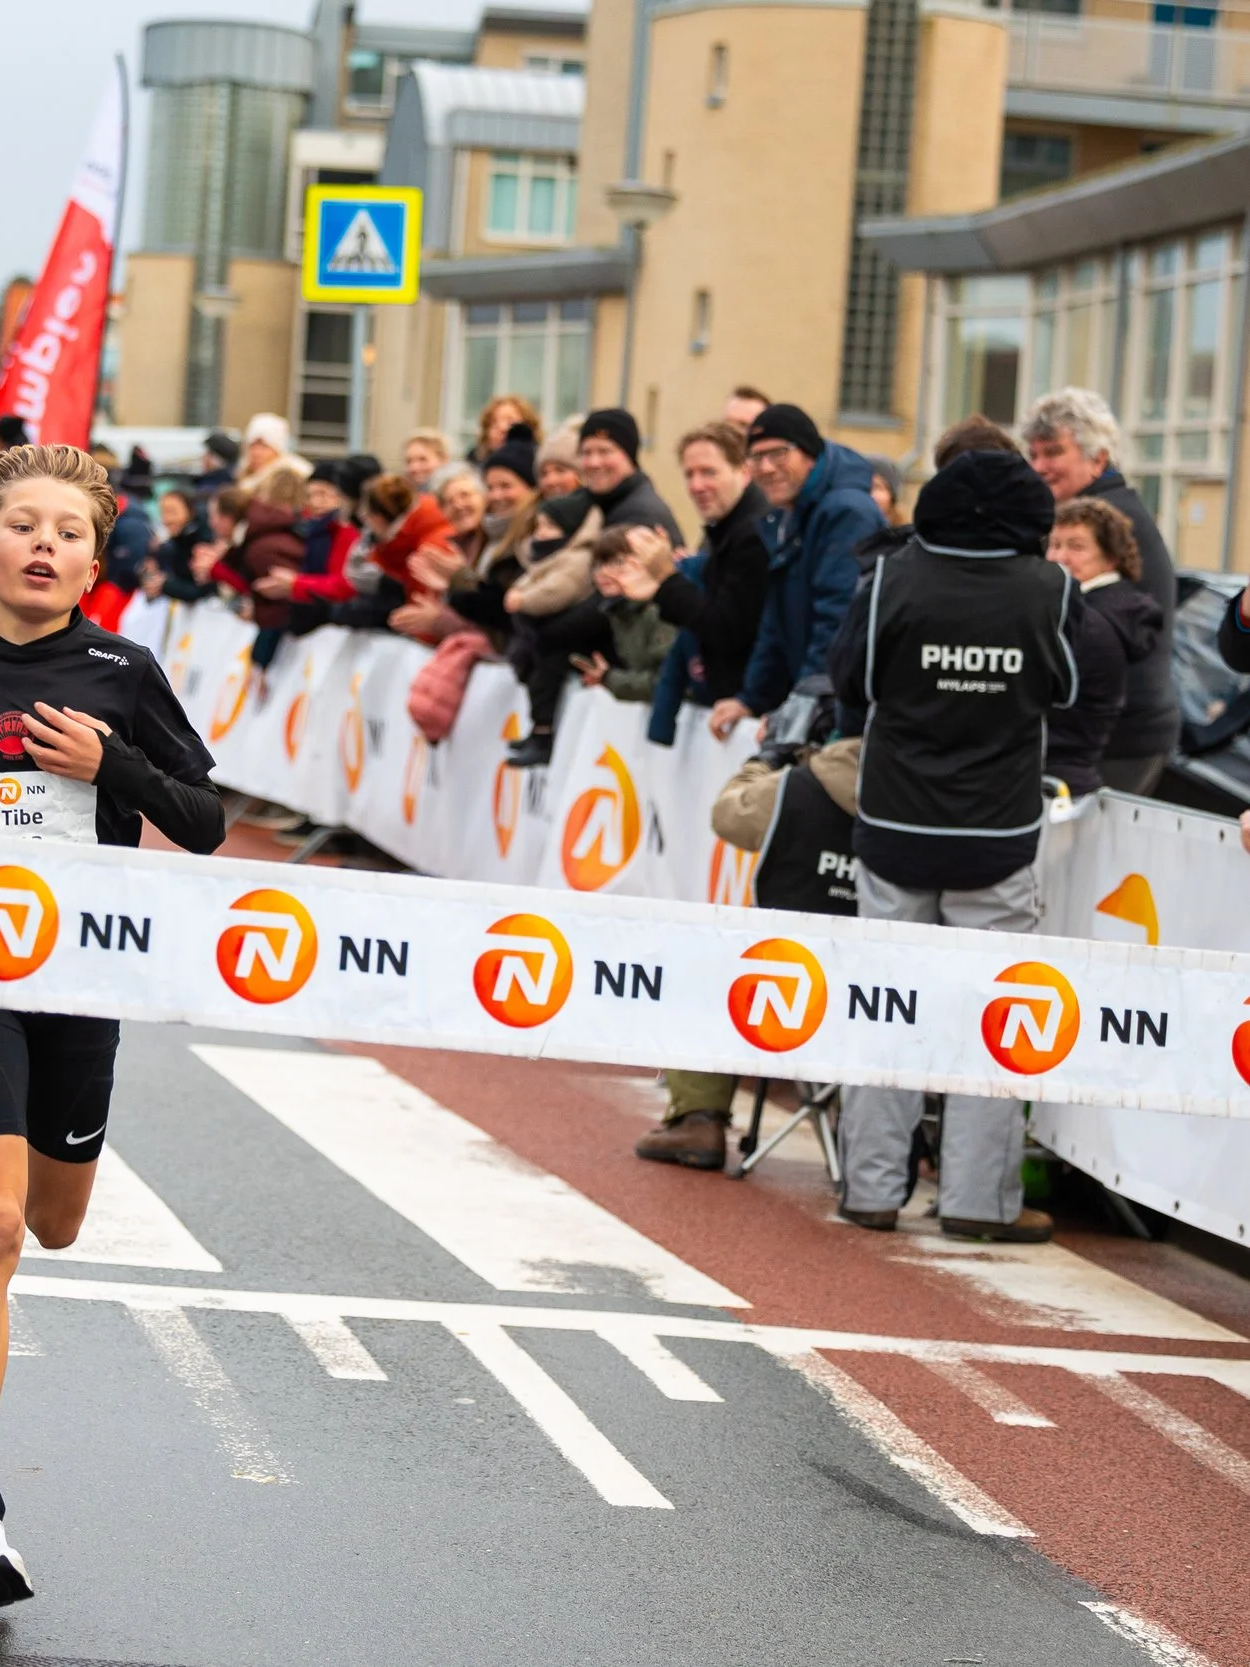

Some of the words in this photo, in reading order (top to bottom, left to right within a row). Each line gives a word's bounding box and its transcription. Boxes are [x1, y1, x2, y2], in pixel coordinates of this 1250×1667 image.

[88, 648, 121, 663] CRAFT
[921, 644, 1024, 674] PHOTO
[26, 785, 46, 795] NN
[1, 808, 44, 826] Tibe
[80, 912, 151, 953] NN
[339, 936, 409, 976] NN
[594, 960, 663, 1001] NN
[848, 984, 917, 1025] NN
[1100, 1006, 1168, 1047] NN
